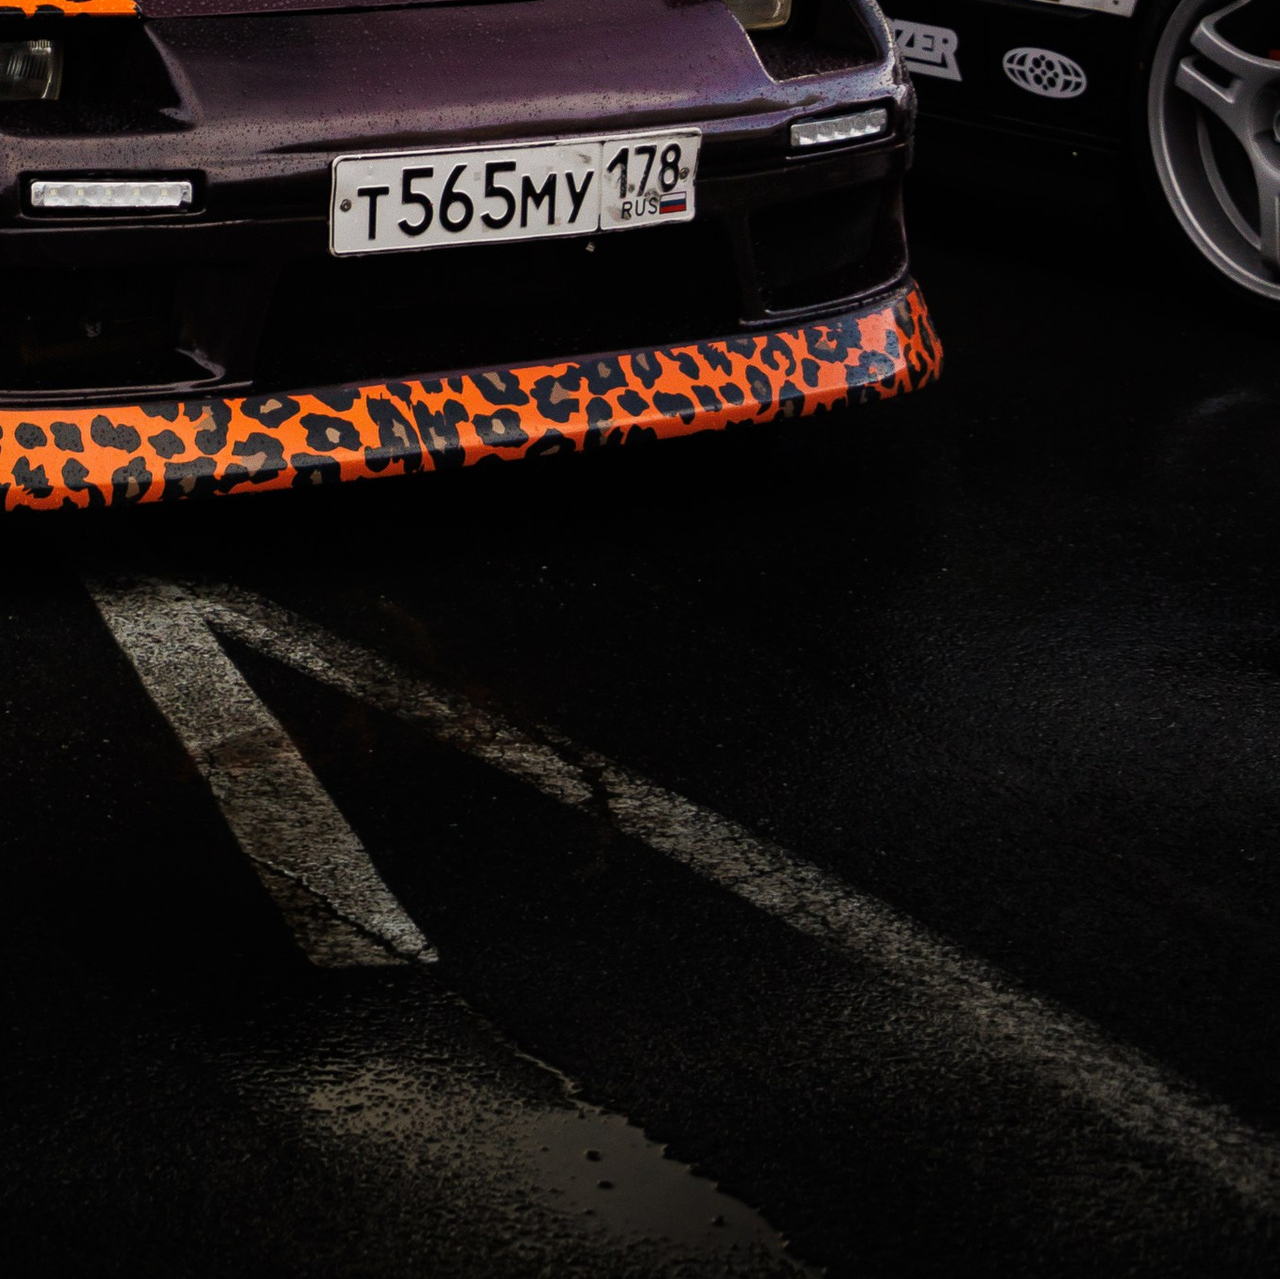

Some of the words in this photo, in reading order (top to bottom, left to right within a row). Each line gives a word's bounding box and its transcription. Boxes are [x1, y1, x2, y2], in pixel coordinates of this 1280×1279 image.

[891, 18, 961, 78] ZER
[606, 142, 681, 199] 178
[621, 195, 660, 220] RUS
